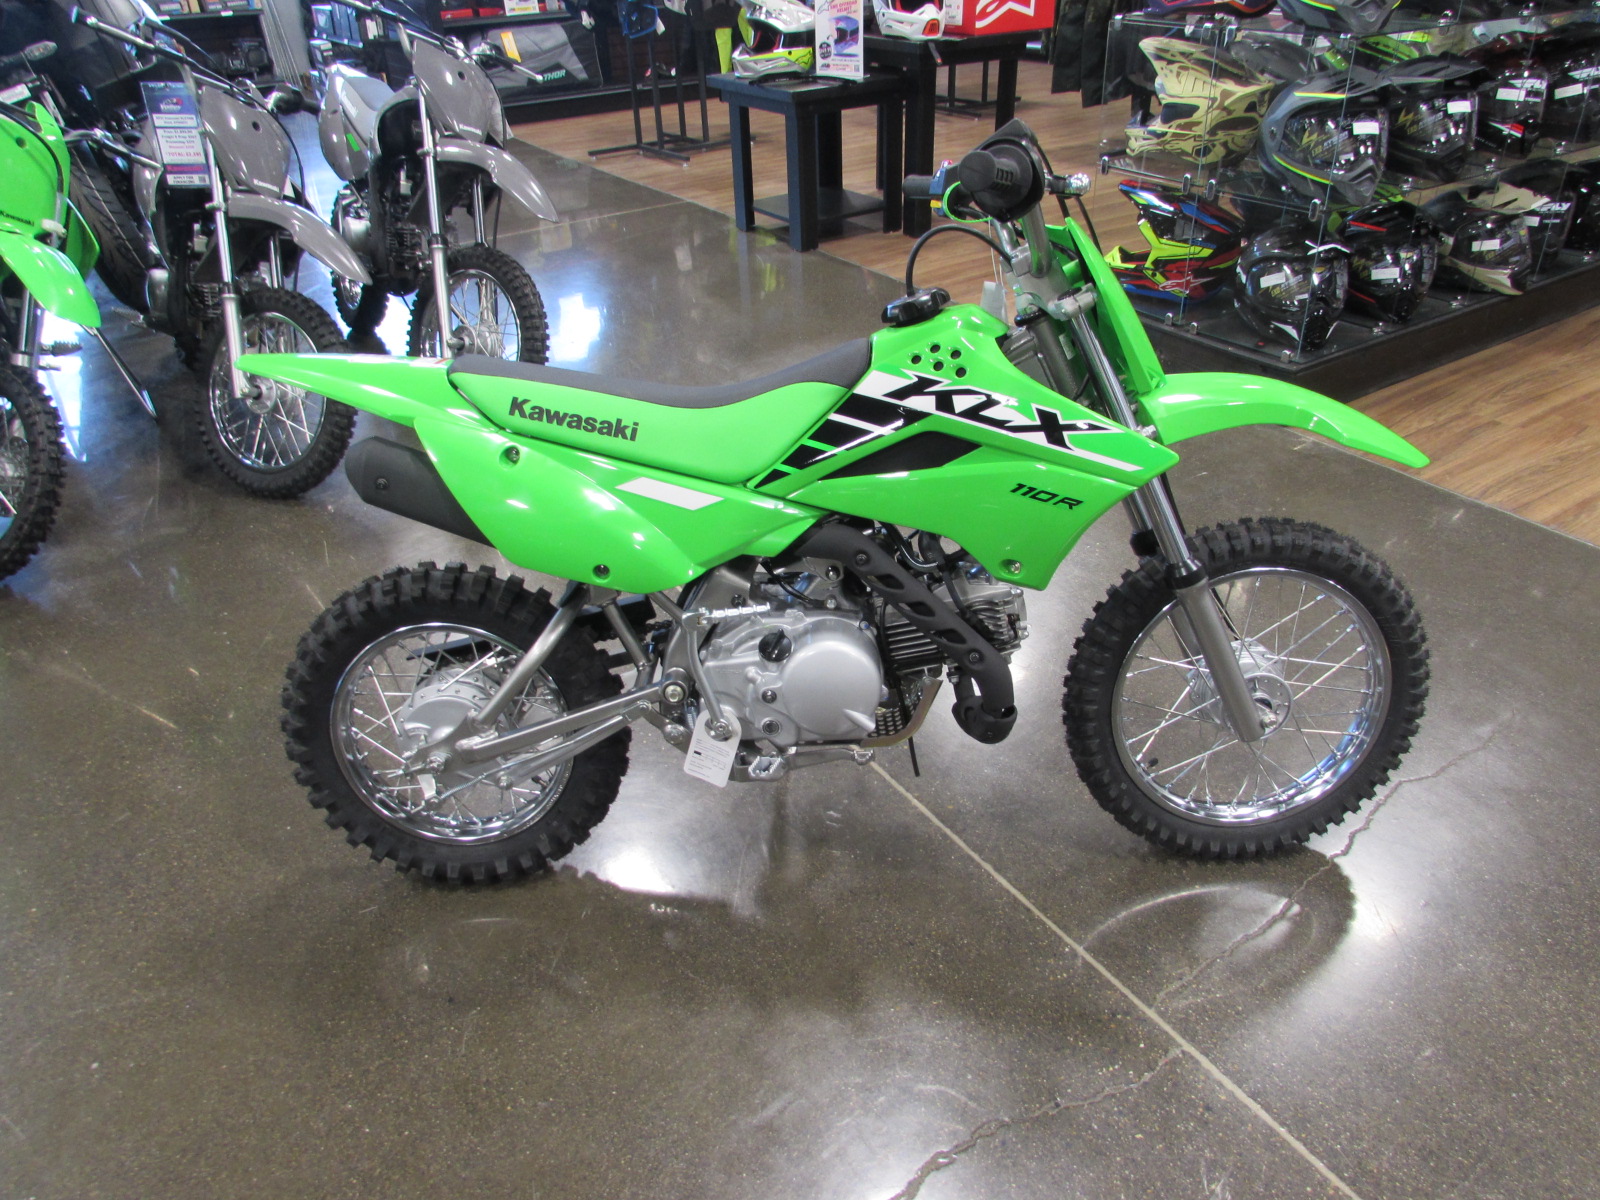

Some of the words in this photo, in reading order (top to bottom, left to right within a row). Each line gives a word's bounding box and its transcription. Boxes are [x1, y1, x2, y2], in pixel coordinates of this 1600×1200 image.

[543, 69, 566, 81] THOR
[508, 396, 639, 442] Kawasaki
[882, 373, 1113, 452] KLX
[1010, 483, 1084, 510] 110R
